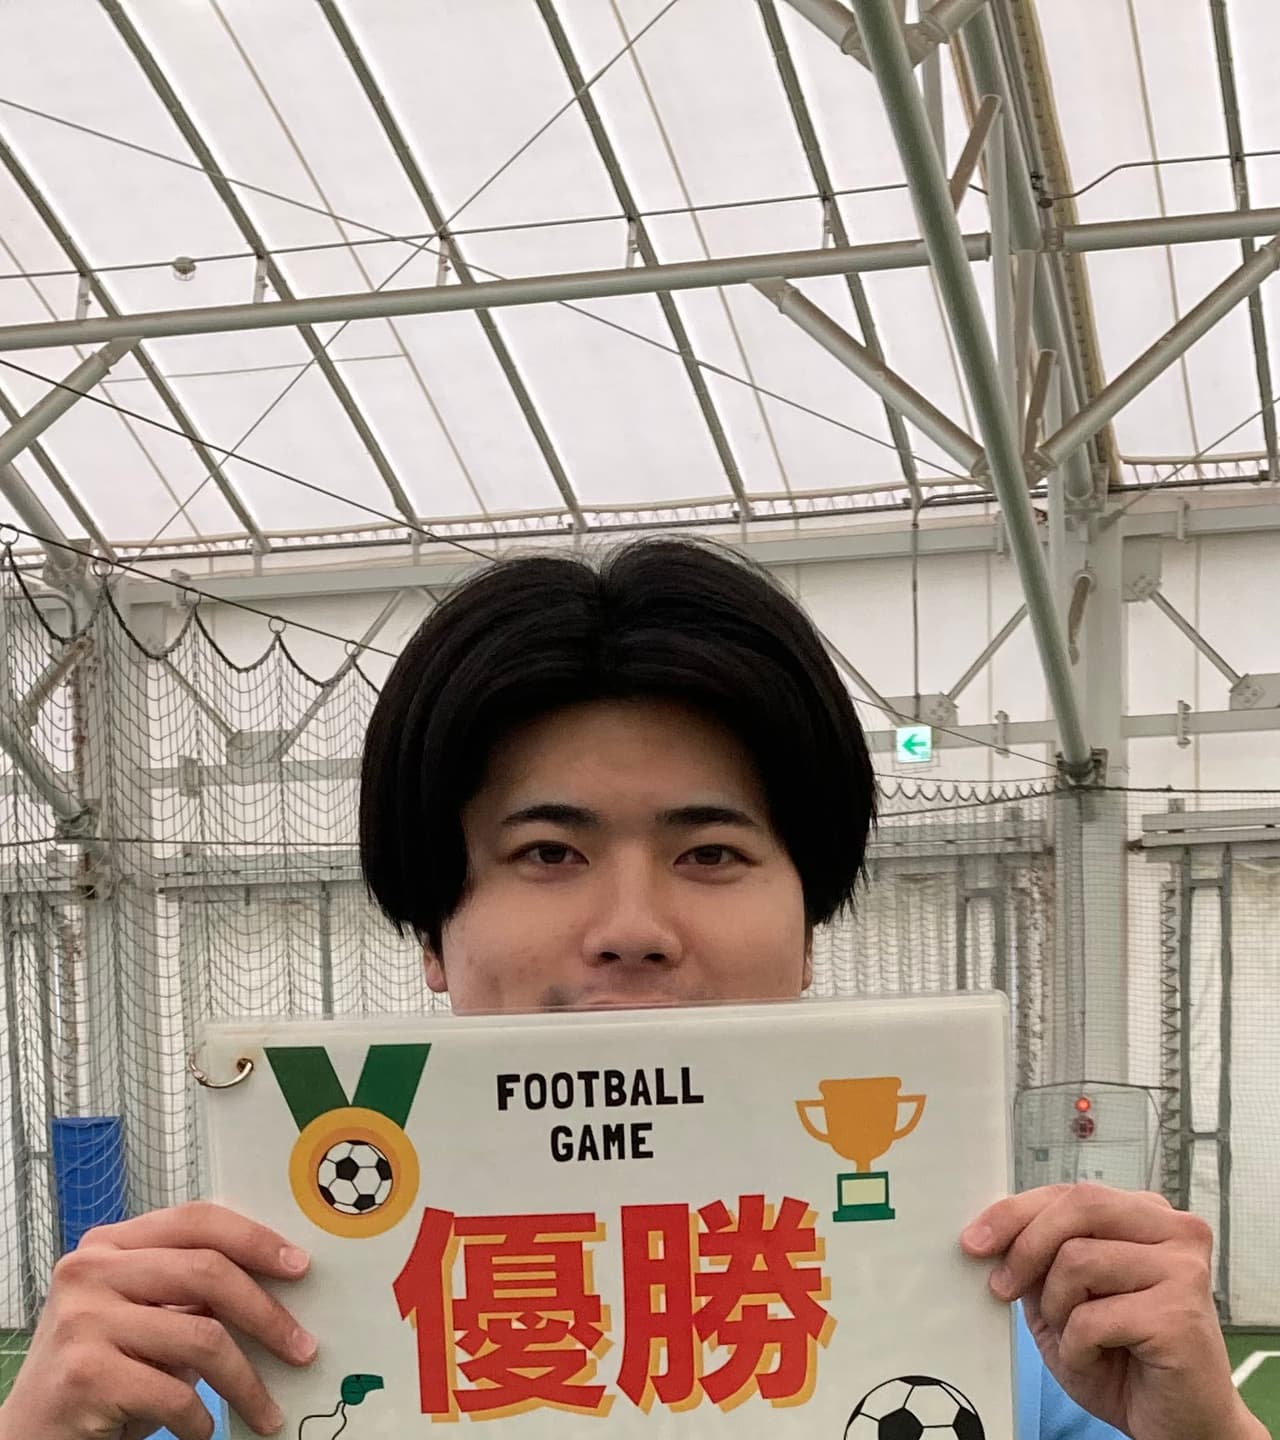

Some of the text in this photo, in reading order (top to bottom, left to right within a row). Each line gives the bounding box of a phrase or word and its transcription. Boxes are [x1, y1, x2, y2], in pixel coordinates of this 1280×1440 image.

[496, 1066, 706, 1111] FOOTBALL
[549, 1122, 655, 1162] GAME
[392, 1193, 835, 1421] 優勝
